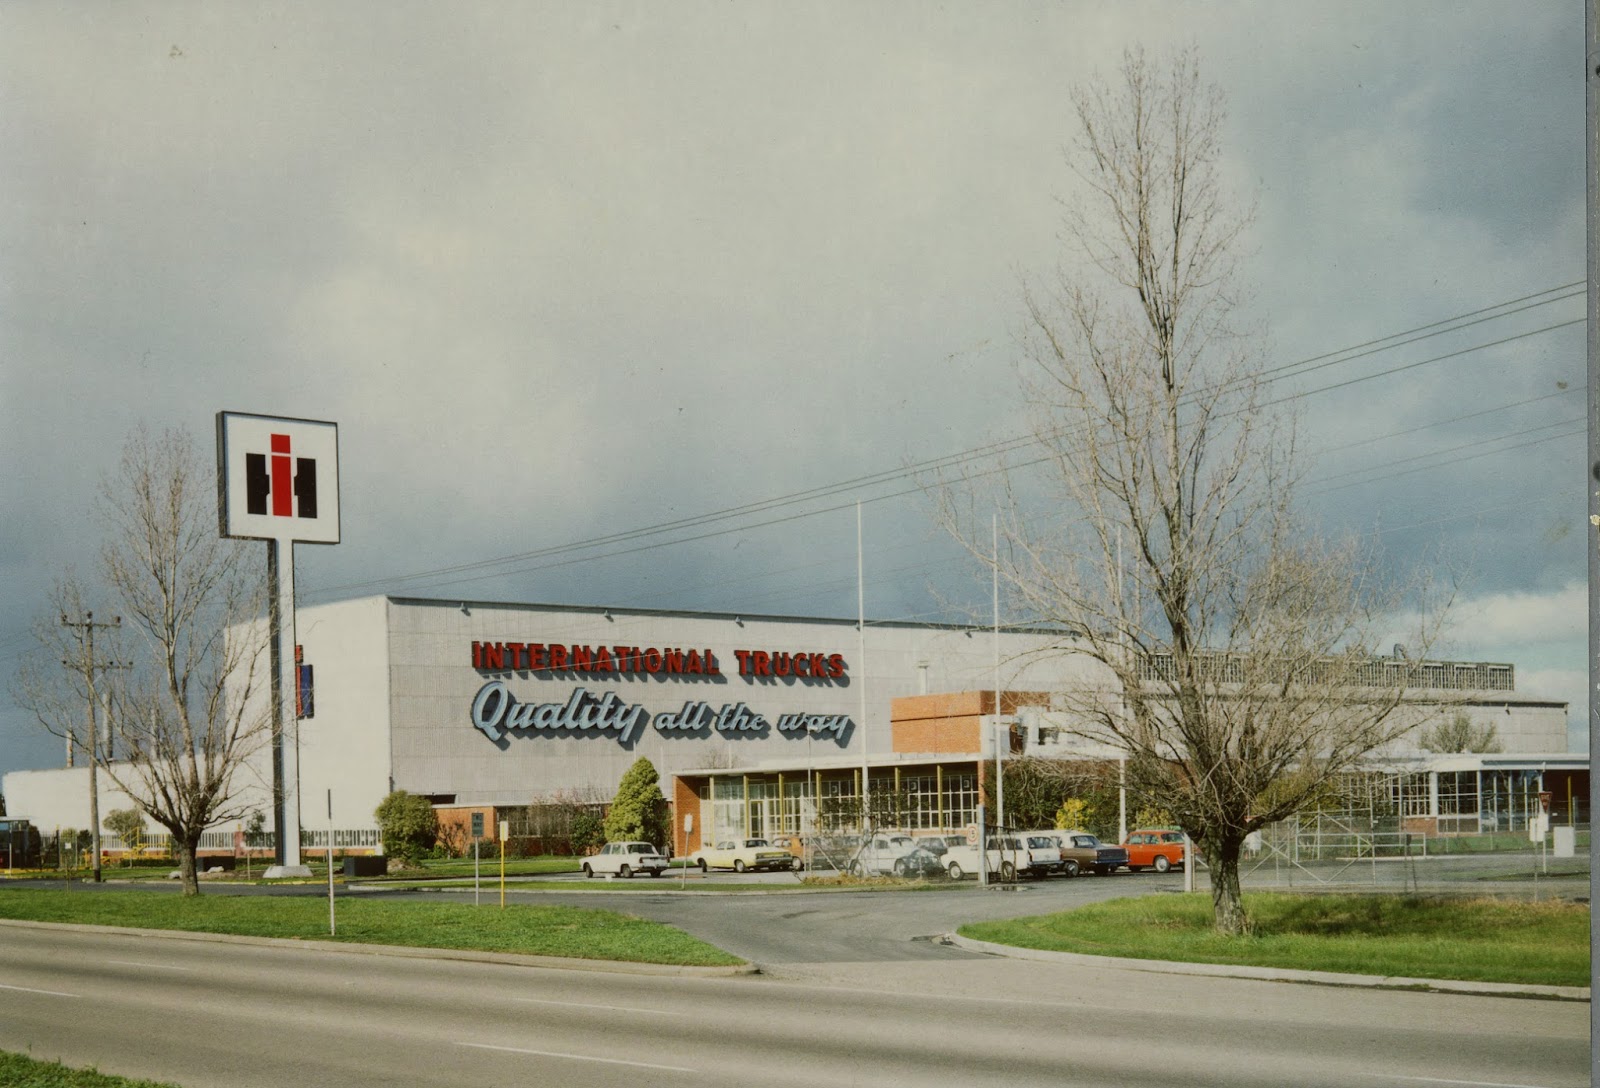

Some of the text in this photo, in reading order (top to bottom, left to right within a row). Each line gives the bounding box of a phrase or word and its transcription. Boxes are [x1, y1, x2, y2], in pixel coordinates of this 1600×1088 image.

[472, 641, 845, 678] INTERNATIONAL TRUCKS
[471, 681, 849, 742] Quality all the way
